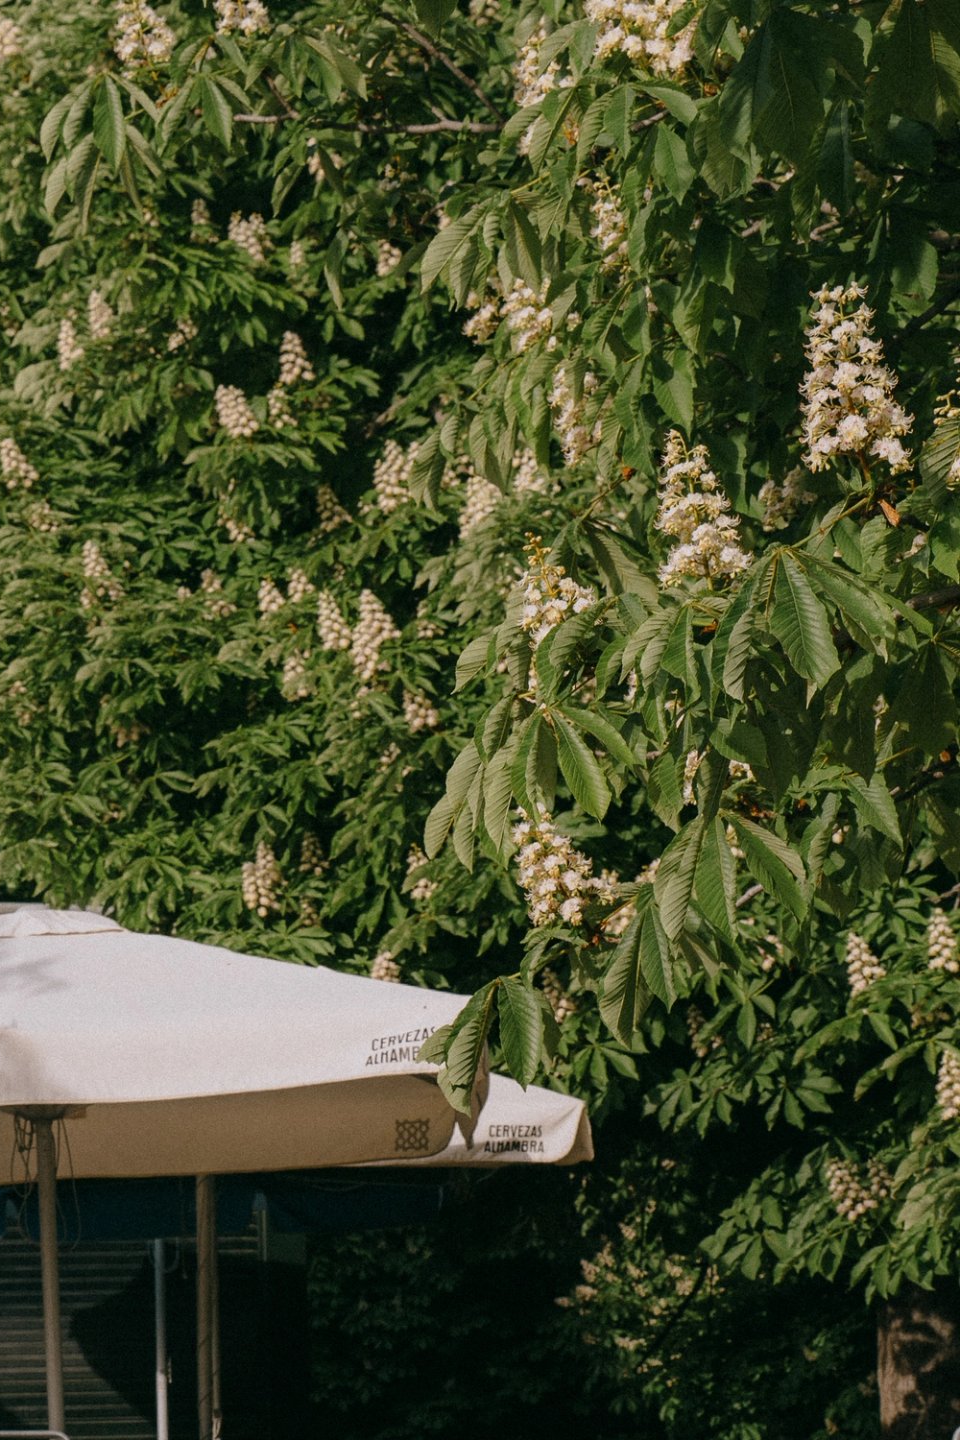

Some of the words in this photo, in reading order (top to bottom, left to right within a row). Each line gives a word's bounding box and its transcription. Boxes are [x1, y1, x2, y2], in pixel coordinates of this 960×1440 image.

[365, 1046, 420, 1066] ALHAMB
[488, 1124, 543, 1138] CERVEZAS
[483, 1140, 545, 1153] ALHAMBRA
